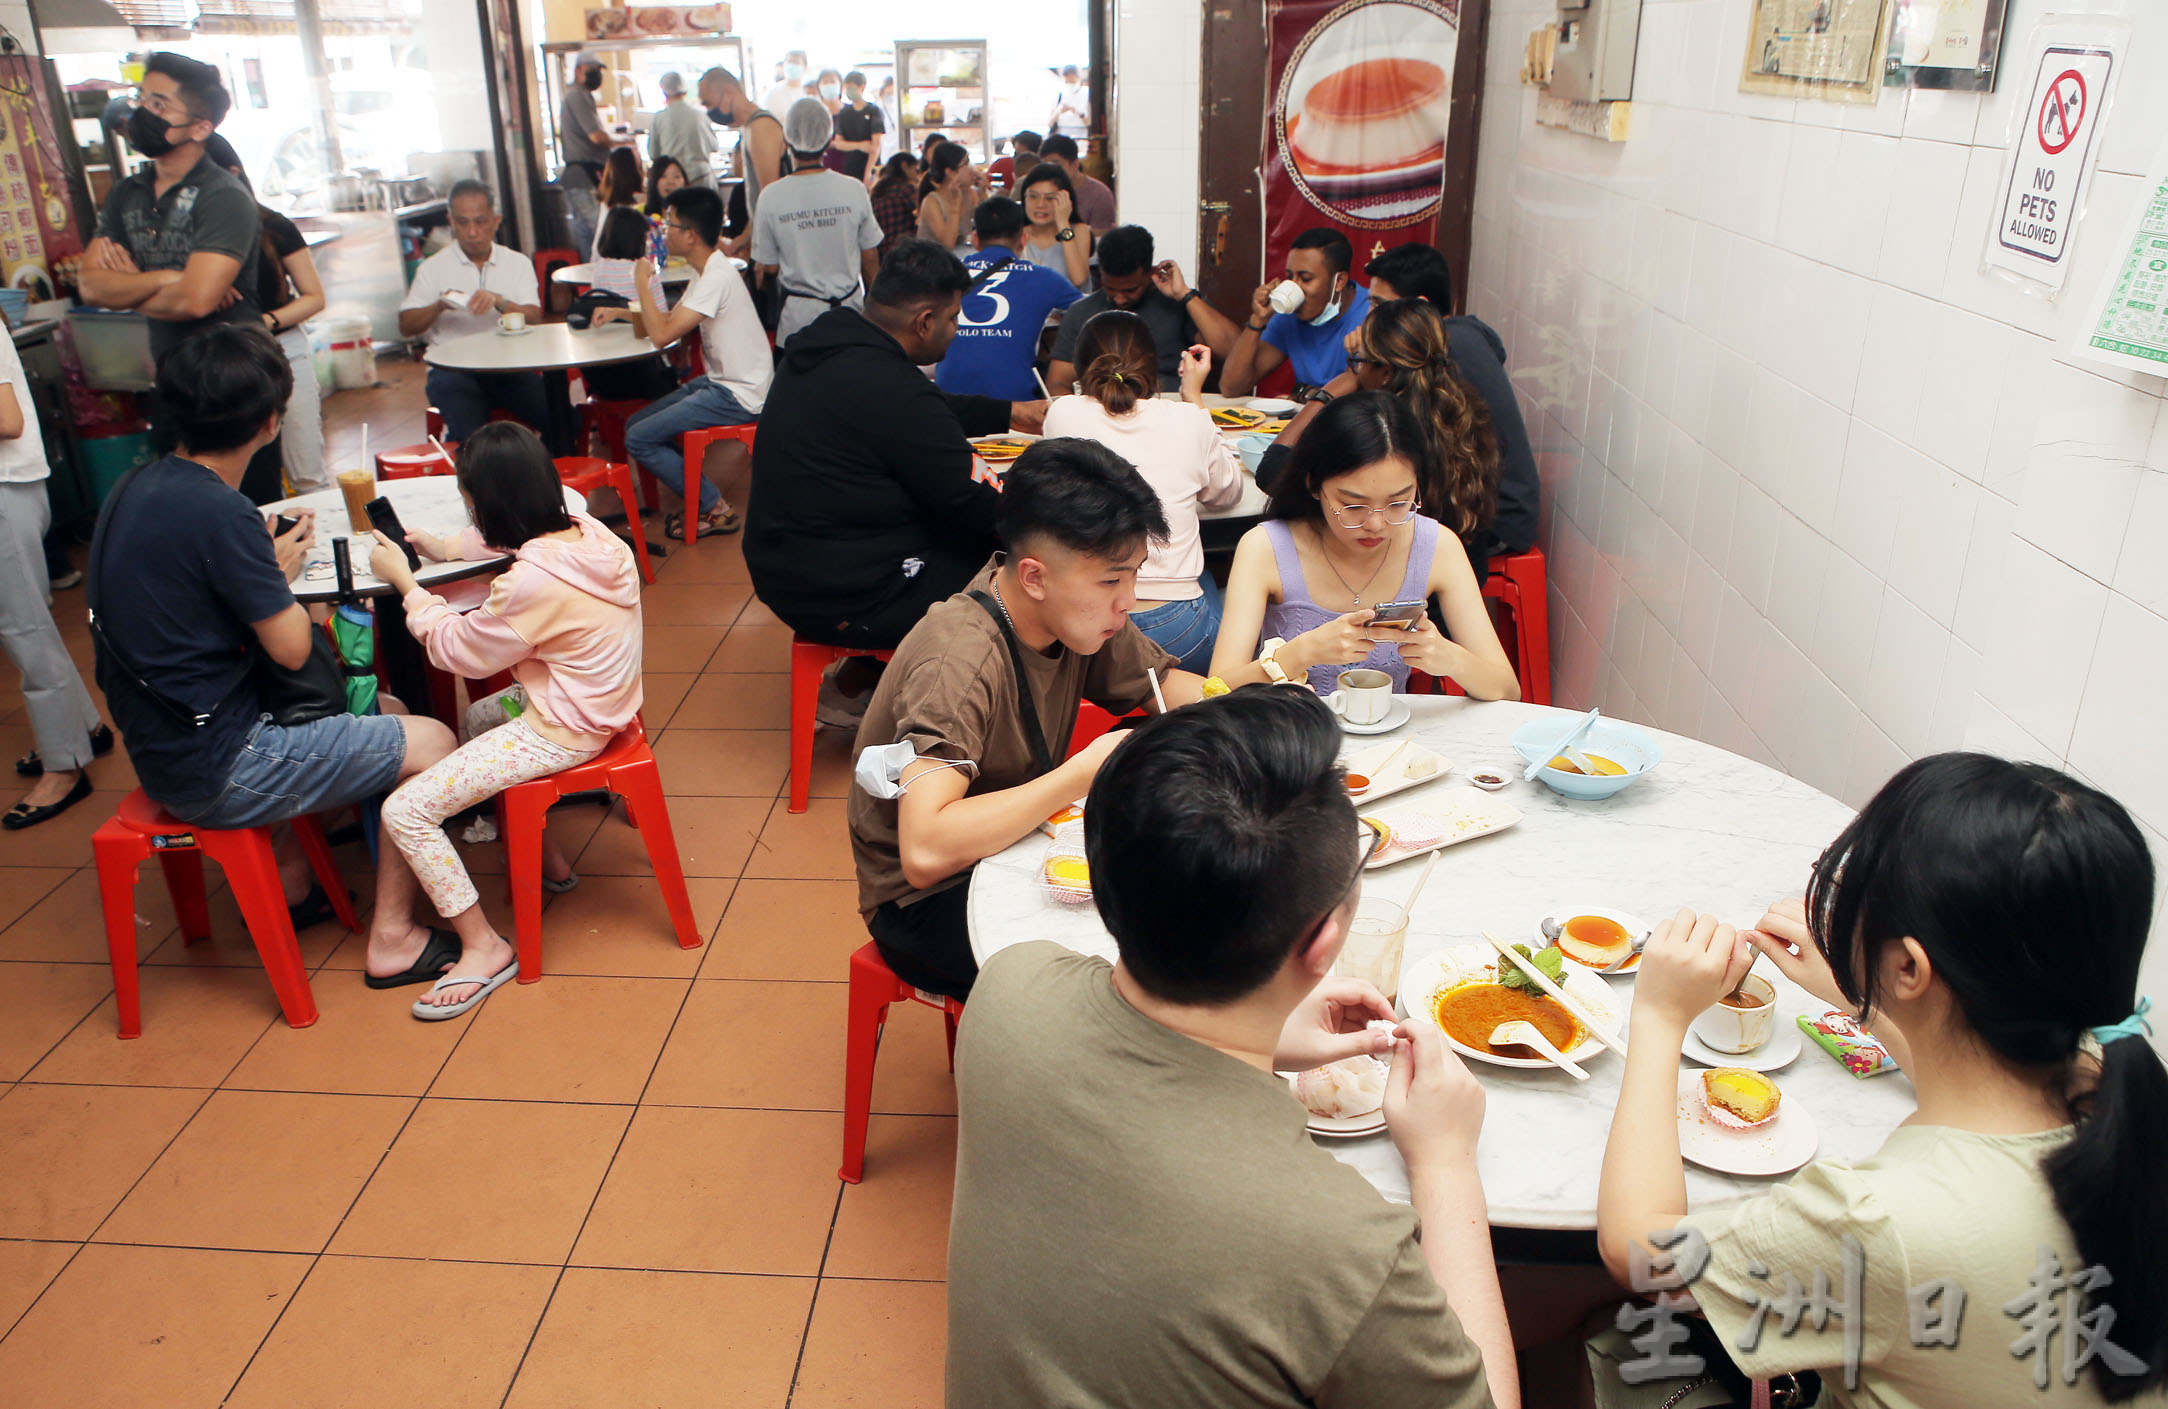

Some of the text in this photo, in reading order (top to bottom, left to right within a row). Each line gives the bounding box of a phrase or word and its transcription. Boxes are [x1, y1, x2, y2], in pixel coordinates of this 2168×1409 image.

[2033, 167, 2055, 192] NO
[813, 206, 852, 218] KITCHEN
[2019, 193, 2057, 223] PETS
[797, 218, 837, 230] SDN BHD
[2010, 219, 2057, 245] ALLOWED
[981, 329, 1012, 338] TEAM
